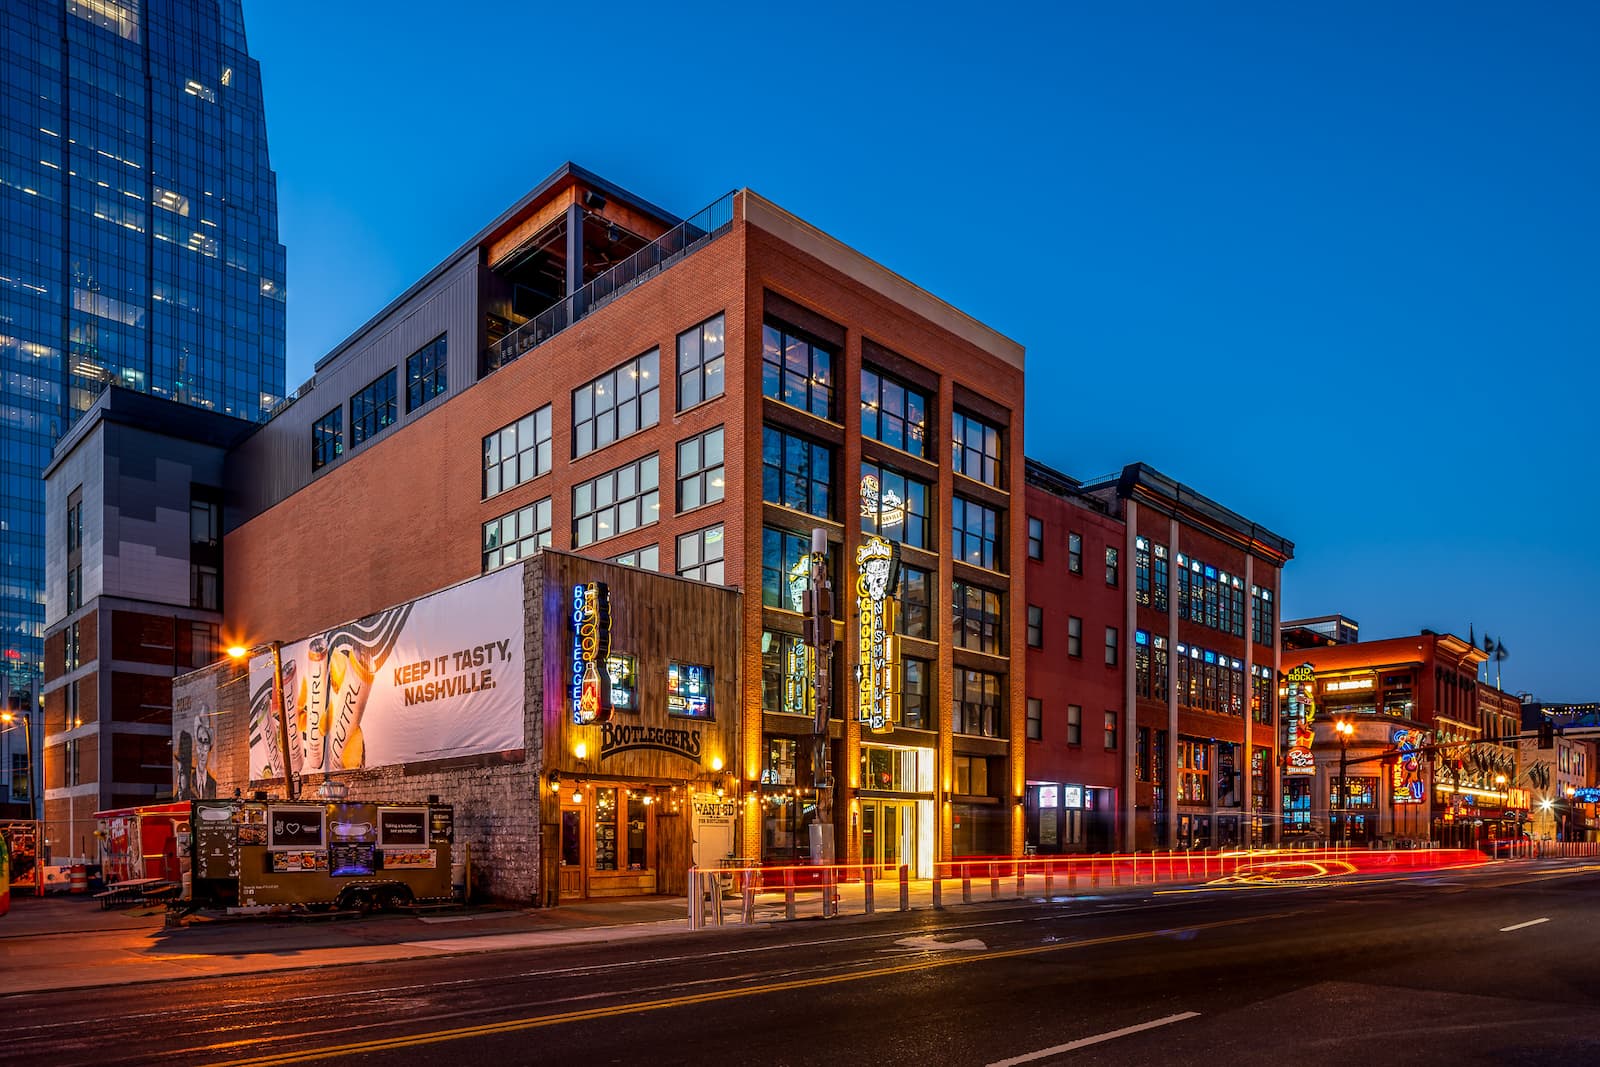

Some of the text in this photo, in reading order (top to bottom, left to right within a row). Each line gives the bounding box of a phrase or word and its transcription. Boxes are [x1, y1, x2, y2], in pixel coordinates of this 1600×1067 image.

[394, 638, 512, 687] KEEP IT TASTY,
[404, 669, 497, 707] NASHVILLE.
[573, 585, 583, 724] BOOTLEGGERS
[860, 598, 871, 719] GOODNIGHT
[873, 599, 883, 729] NASHVILLE
[601, 722, 701, 756] BOOTLEGGERS
